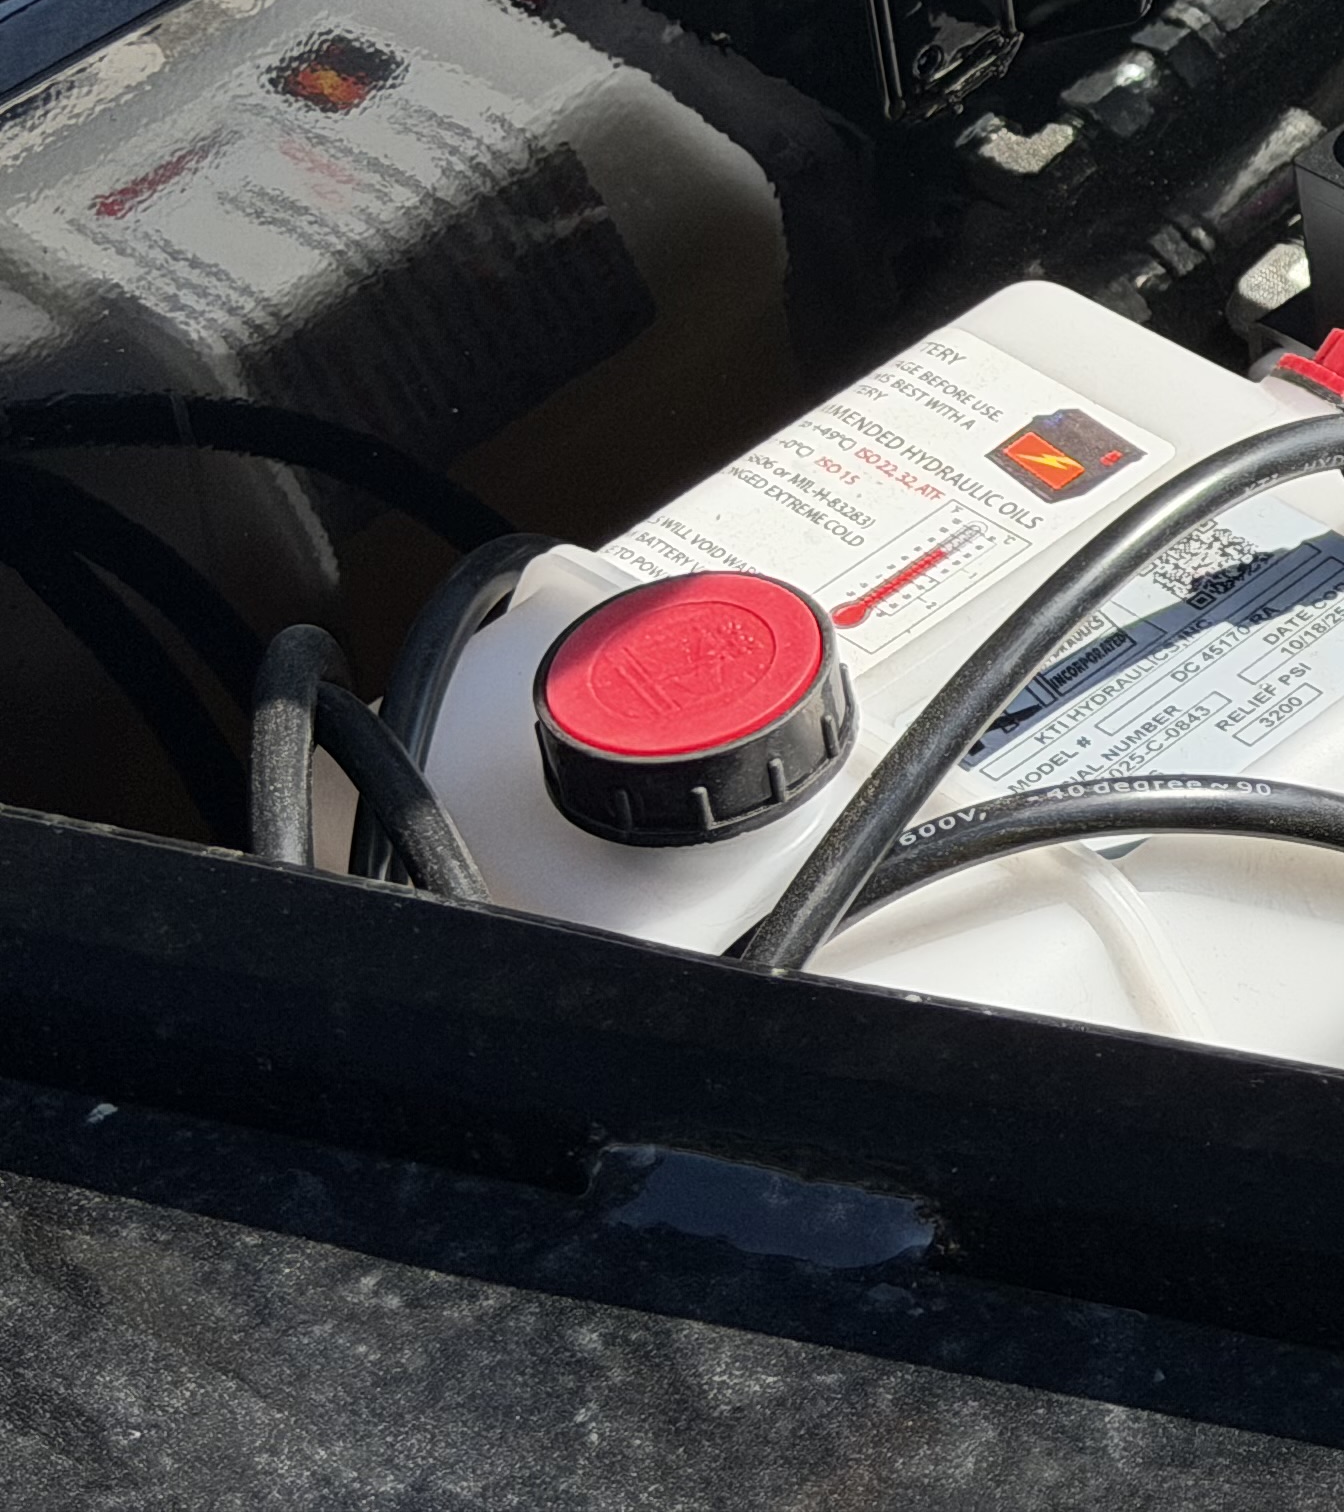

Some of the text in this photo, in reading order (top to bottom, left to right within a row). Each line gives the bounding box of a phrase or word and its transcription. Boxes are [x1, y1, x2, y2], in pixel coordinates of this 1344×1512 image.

[889, 378, 930, 402] BEST
[923, 396, 966, 424] WITH
[923, 374, 975, 405] BEFORE
[971, 399, 1004, 423] USE.
[772, 467, 790, 478] or
[813, 455, 843, 474] ISO
[839, 470, 861, 486] 15
[854, 446, 882, 465] ISO
[914, 483, 946, 500] ATF
[900, 445, 1044, 530] HYDRAULIC OILS
[660, 517, 693, 540] WILL
[690, 533, 727, 559] VOID
[763, 484, 865, 547] EXTREME COLD
[635, 531, 693, 566] BATTERY
[1168, 601, 1283, 683] DC 45170 RA
[1262, 609, 1313, 646] DATE
[1043, 630, 1133, 690] INCORPORATED
[1214, 662, 1312, 732] RELIEF PSI
[1258, 695, 1304, 729] 3200
[1033, 720, 1074, 747] KTI
[1101, 705, 1181, 762] NUMBER
[1007, 750, 1079, 797] MODEL
[899, 809, 988, 847] 600V,
[1093, 779, 1202, 794] degree
[1235, 782, 1272, 796] 90
